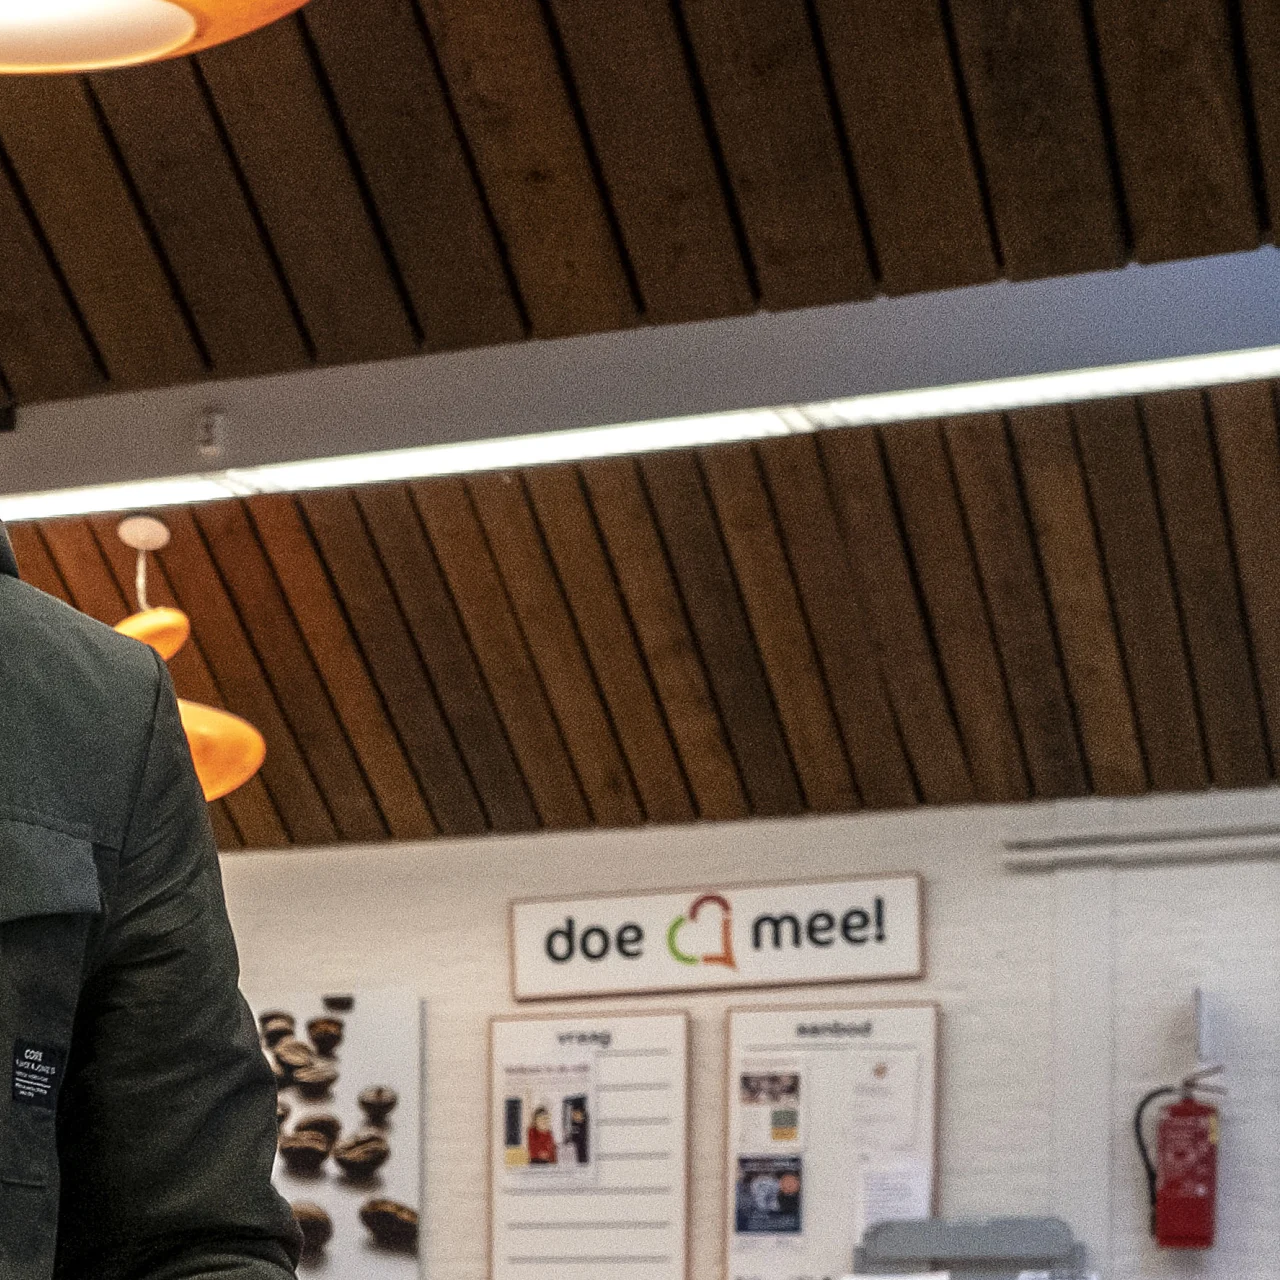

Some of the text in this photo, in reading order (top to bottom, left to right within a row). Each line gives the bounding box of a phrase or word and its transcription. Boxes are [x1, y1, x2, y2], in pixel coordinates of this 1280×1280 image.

[545, 897, 887, 965] doe mee!
[557, 1031, 613, 1048] vraag
